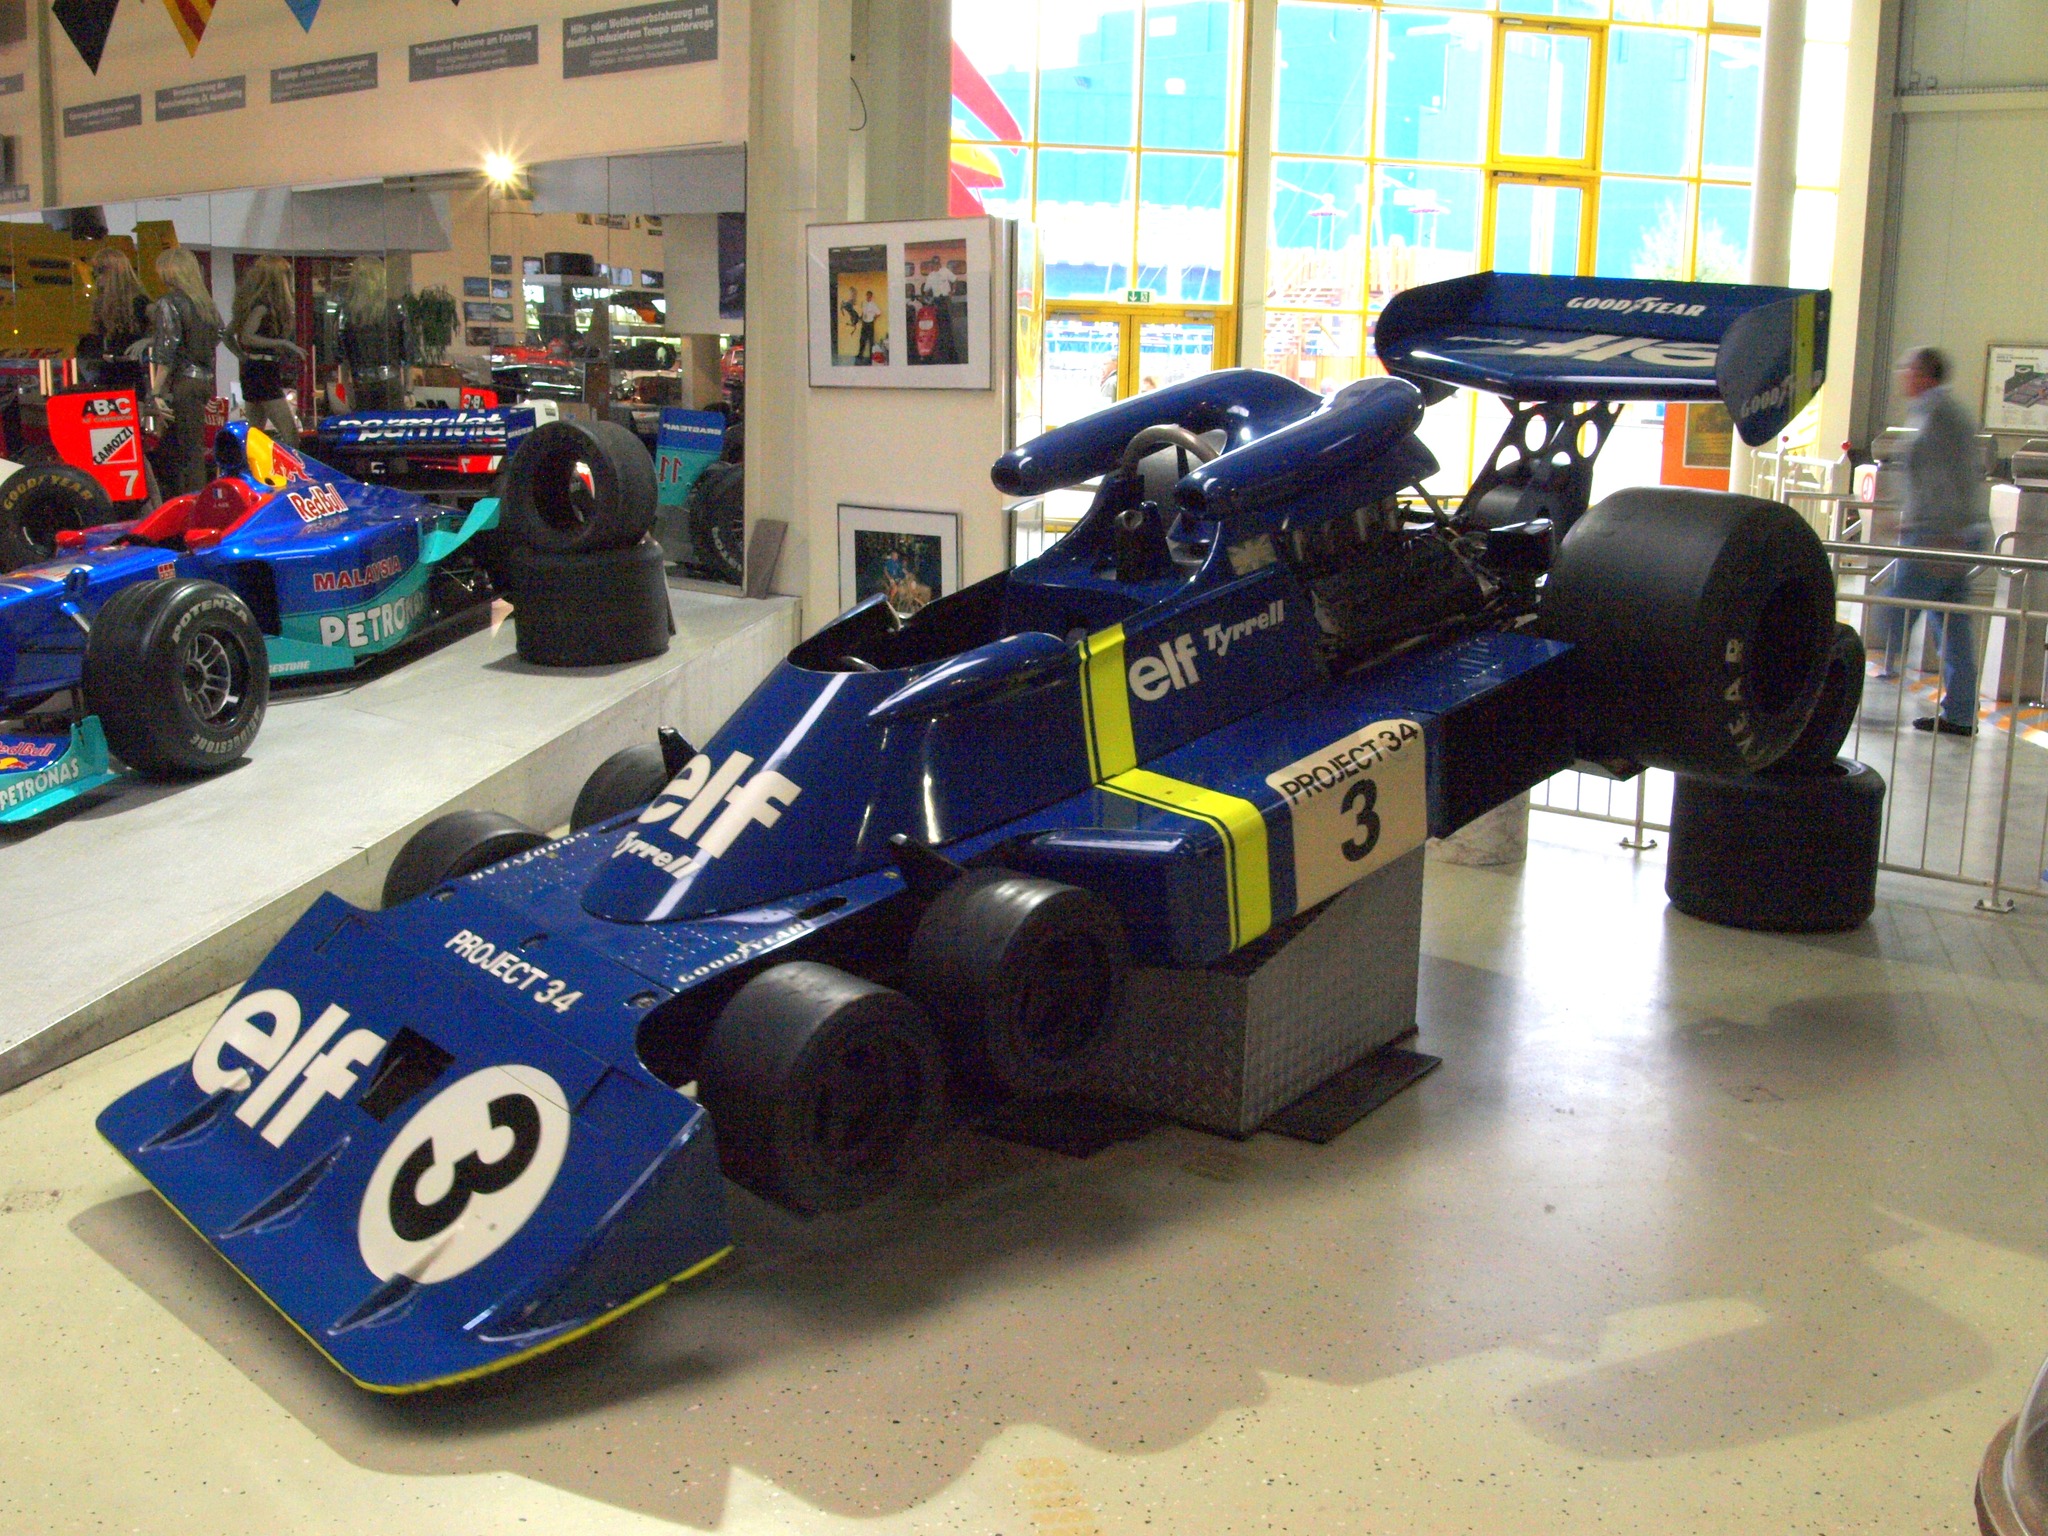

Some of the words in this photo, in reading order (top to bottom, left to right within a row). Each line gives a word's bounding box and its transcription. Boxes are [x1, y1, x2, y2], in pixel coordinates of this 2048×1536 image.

[670, 18, 714, 33] unterwegs
[1565, 295, 1708, 318] GOODYEAR
[93, 426, 134, 465] CAMOZZI
[119, 469, 139, 497] 7
[313, 554, 402, 592] MALAYSIA
[172, 598, 248, 644] POTENZA
[319, 590, 424, 648] PETRONA
[269, 660, 311, 674] ESTONE
[1128, 632, 1200, 702] elf
[1203, 599, 1285, 657] Tyrrell
[0, 757, 80, 811] PETRONAS
[1279, 738, 1384, 806] PROJECT
[1377, 722, 1419, 754] 34
[637, 750, 803, 860] elf
[1340, 778, 1381, 863] 3
[611, 830, 705, 880] Tyrrell
[444, 928, 552, 1002] PROJECT
[533, 977, 585, 1014] 34
[678, 922, 805, 984] GOODYEAR
[191, 988, 389, 1150] elf
[387, 1093, 542, 1244] 3
